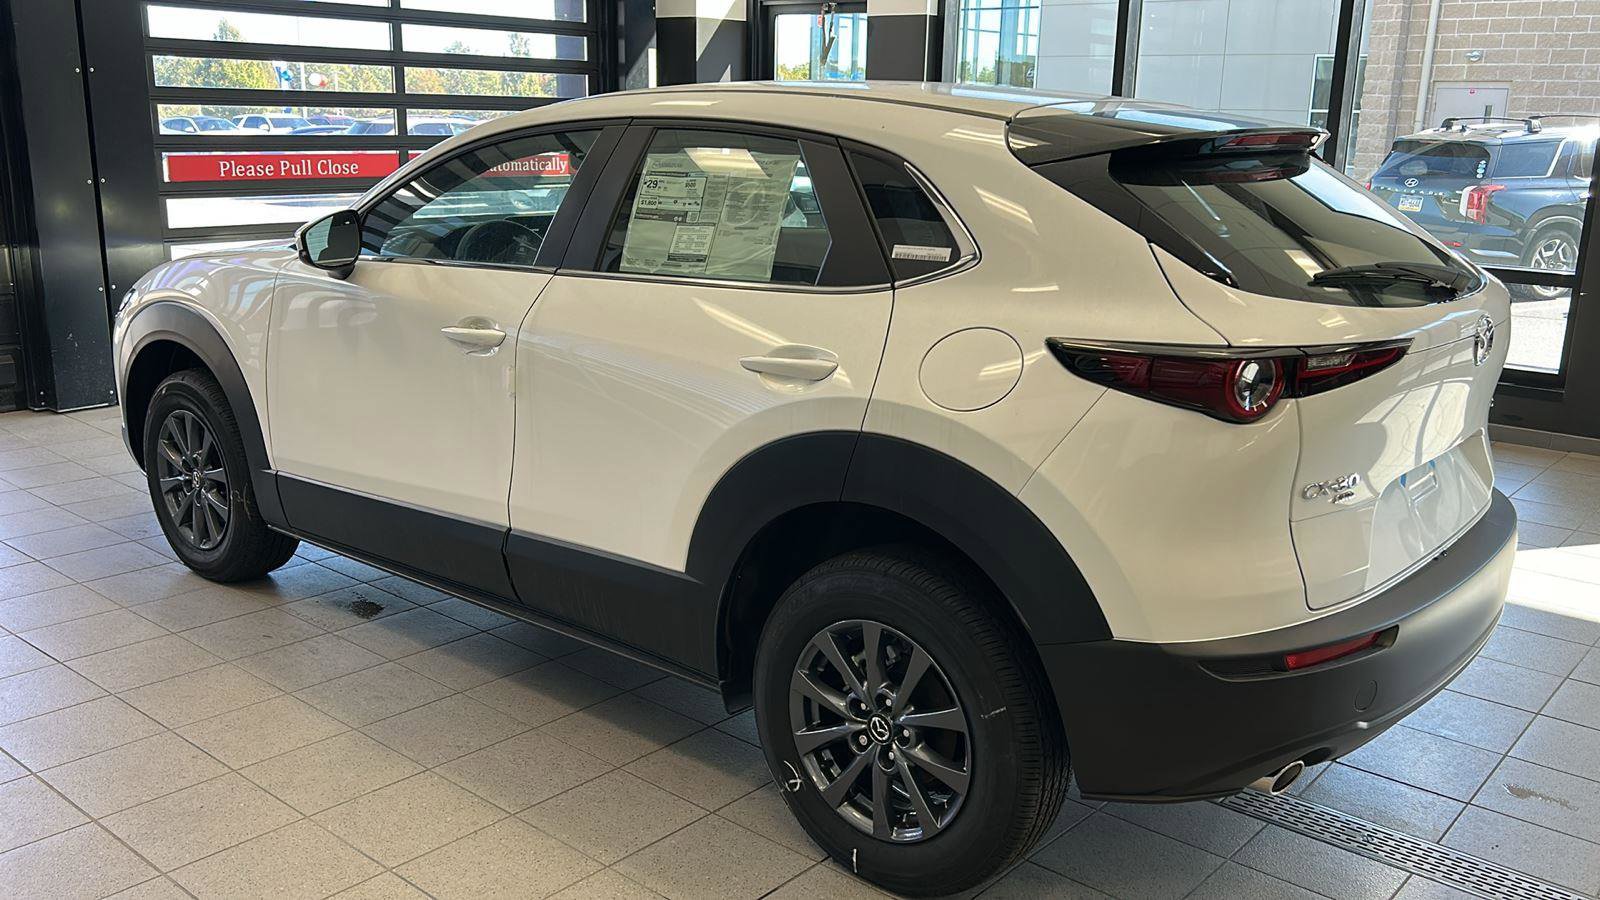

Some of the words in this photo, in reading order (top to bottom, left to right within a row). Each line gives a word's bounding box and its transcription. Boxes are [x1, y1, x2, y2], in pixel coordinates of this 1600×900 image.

[219, 160, 275, 176] Please
[280, 159, 312, 175] Pull
[317, 159, 359, 174] Close
